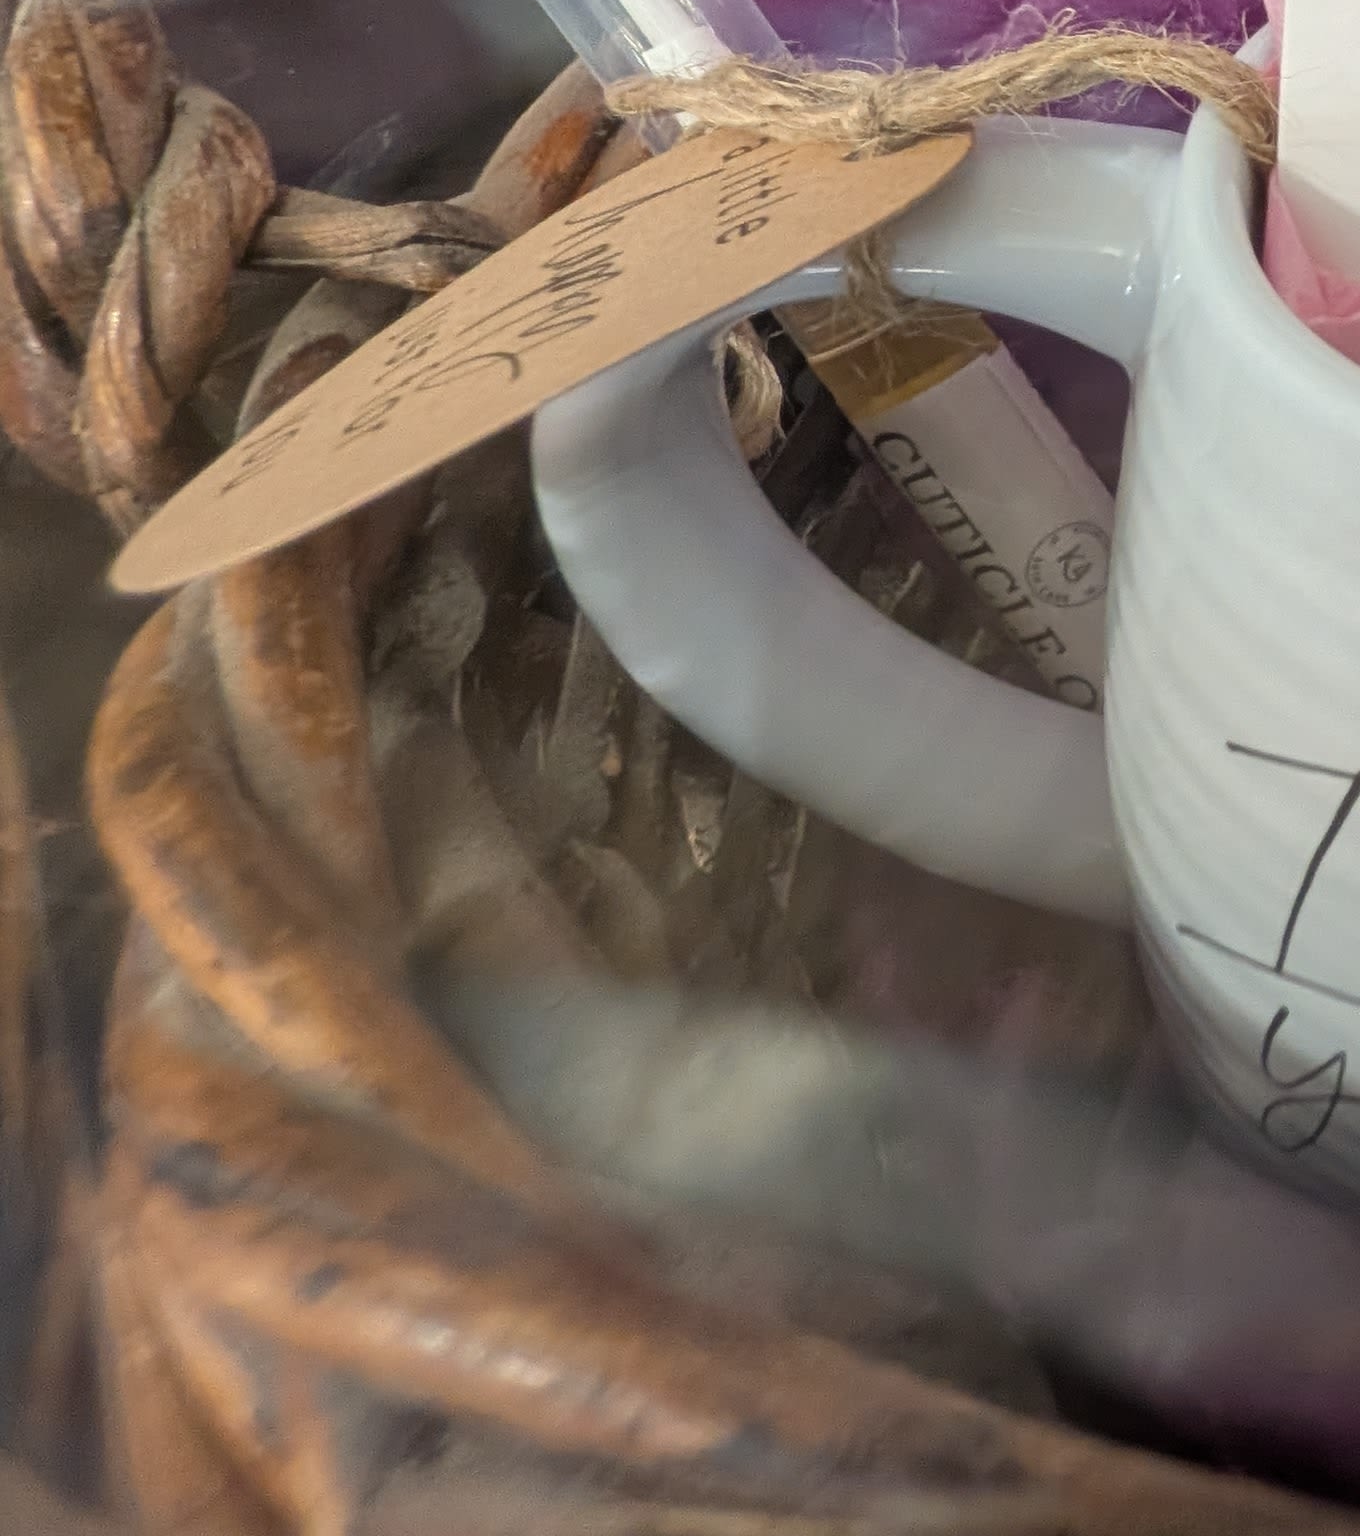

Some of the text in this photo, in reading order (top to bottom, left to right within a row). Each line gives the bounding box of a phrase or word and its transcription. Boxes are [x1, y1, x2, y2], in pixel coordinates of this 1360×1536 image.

[714, 136, 799, 246] a little
[873, 431, 1067, 657] CUTICLE
